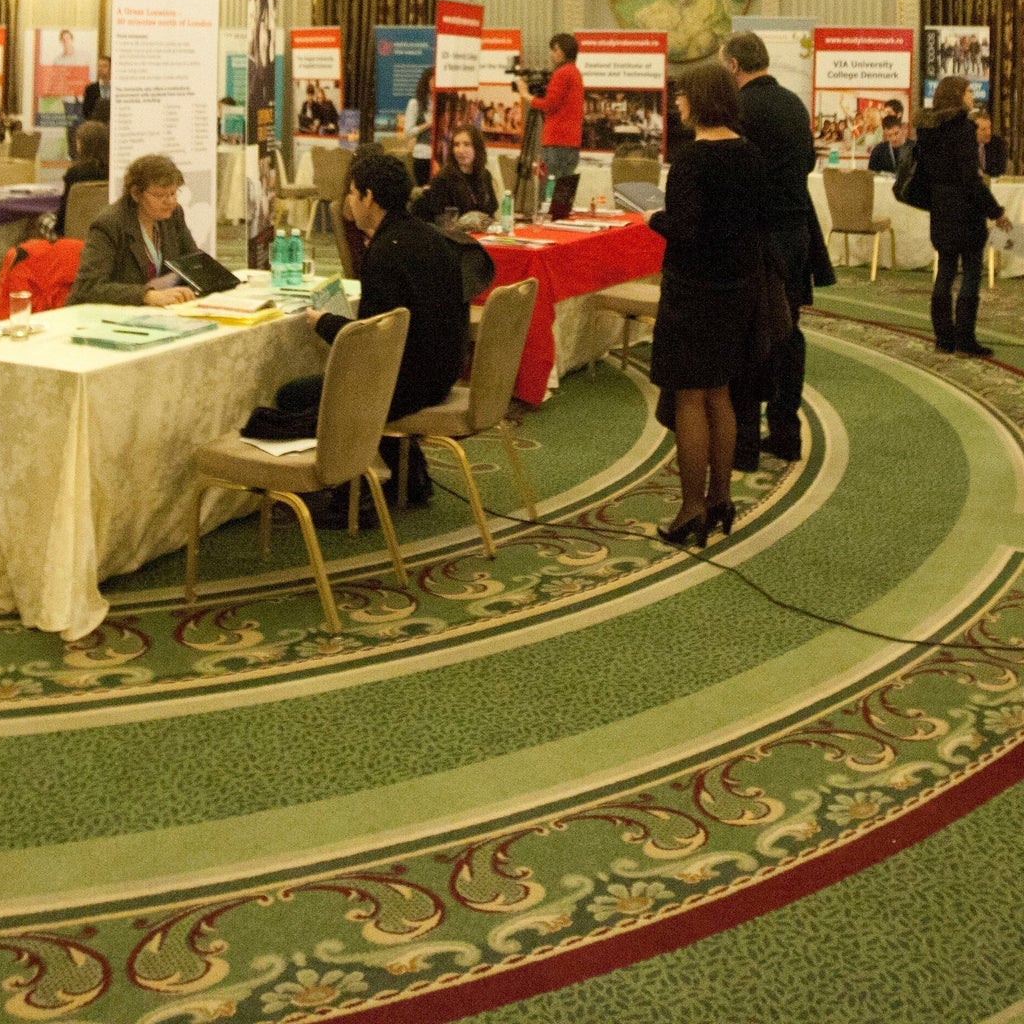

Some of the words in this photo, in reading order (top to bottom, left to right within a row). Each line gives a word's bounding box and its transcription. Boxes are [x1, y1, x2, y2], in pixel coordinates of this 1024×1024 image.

[833, 60, 848, 68] VIA
[851, 60, 893, 70] University
[827, 71, 858, 80] College
[861, 71, 899, 79] Denmark
